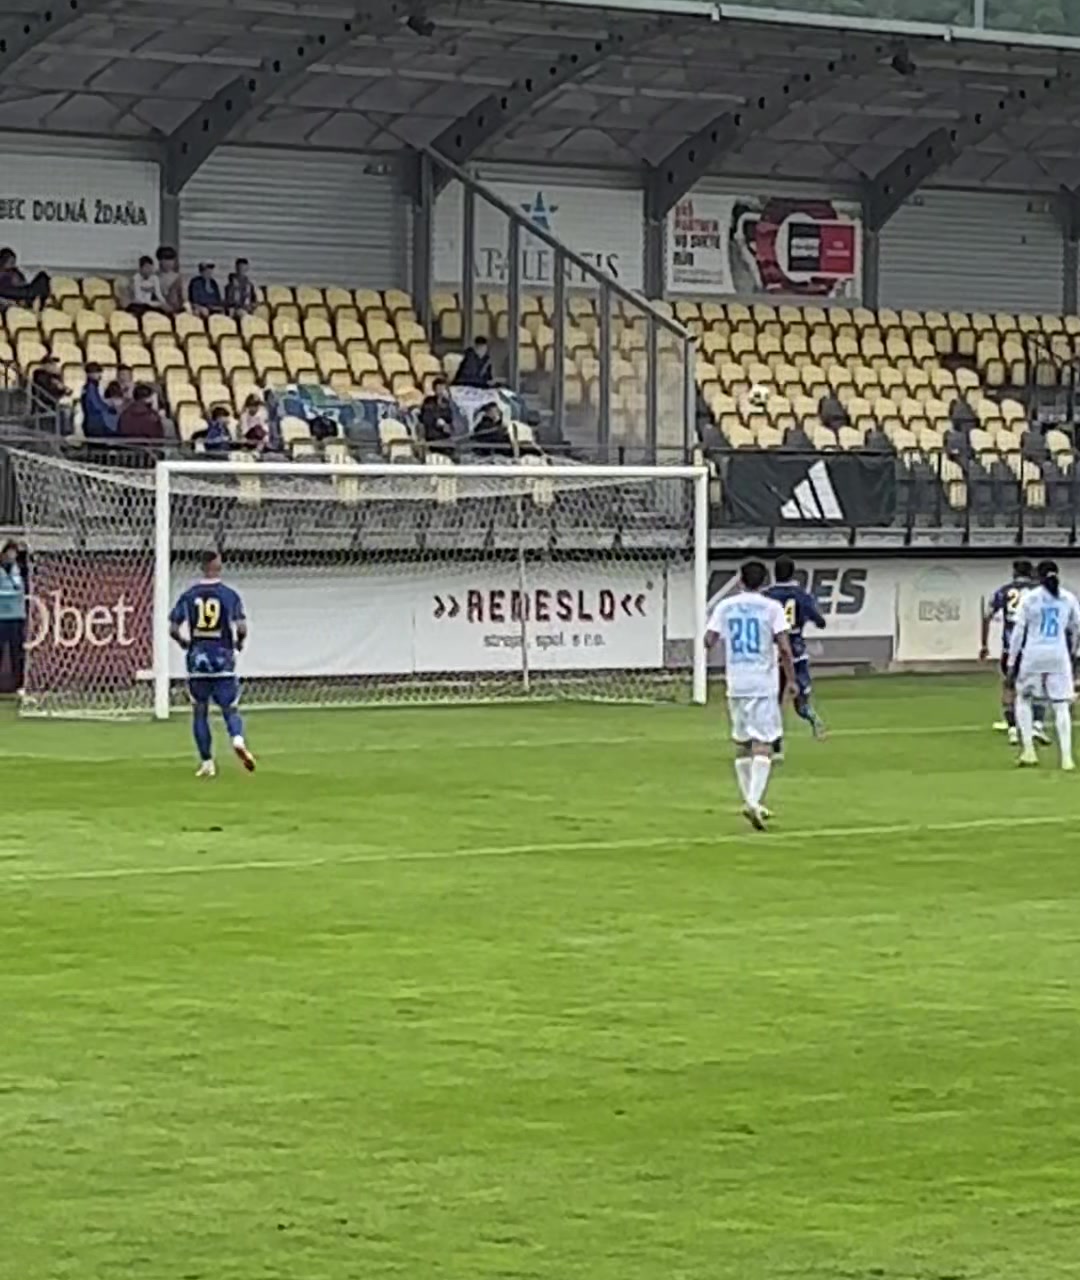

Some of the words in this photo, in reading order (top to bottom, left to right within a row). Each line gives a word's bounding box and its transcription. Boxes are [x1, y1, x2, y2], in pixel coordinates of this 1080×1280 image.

[32, 197, 88, 223] DOLNÁ
[94, 198, 148, 226] ŽDAŇA
[194, 597, 222, 629] 19
[728, 617, 761, 654] 20
